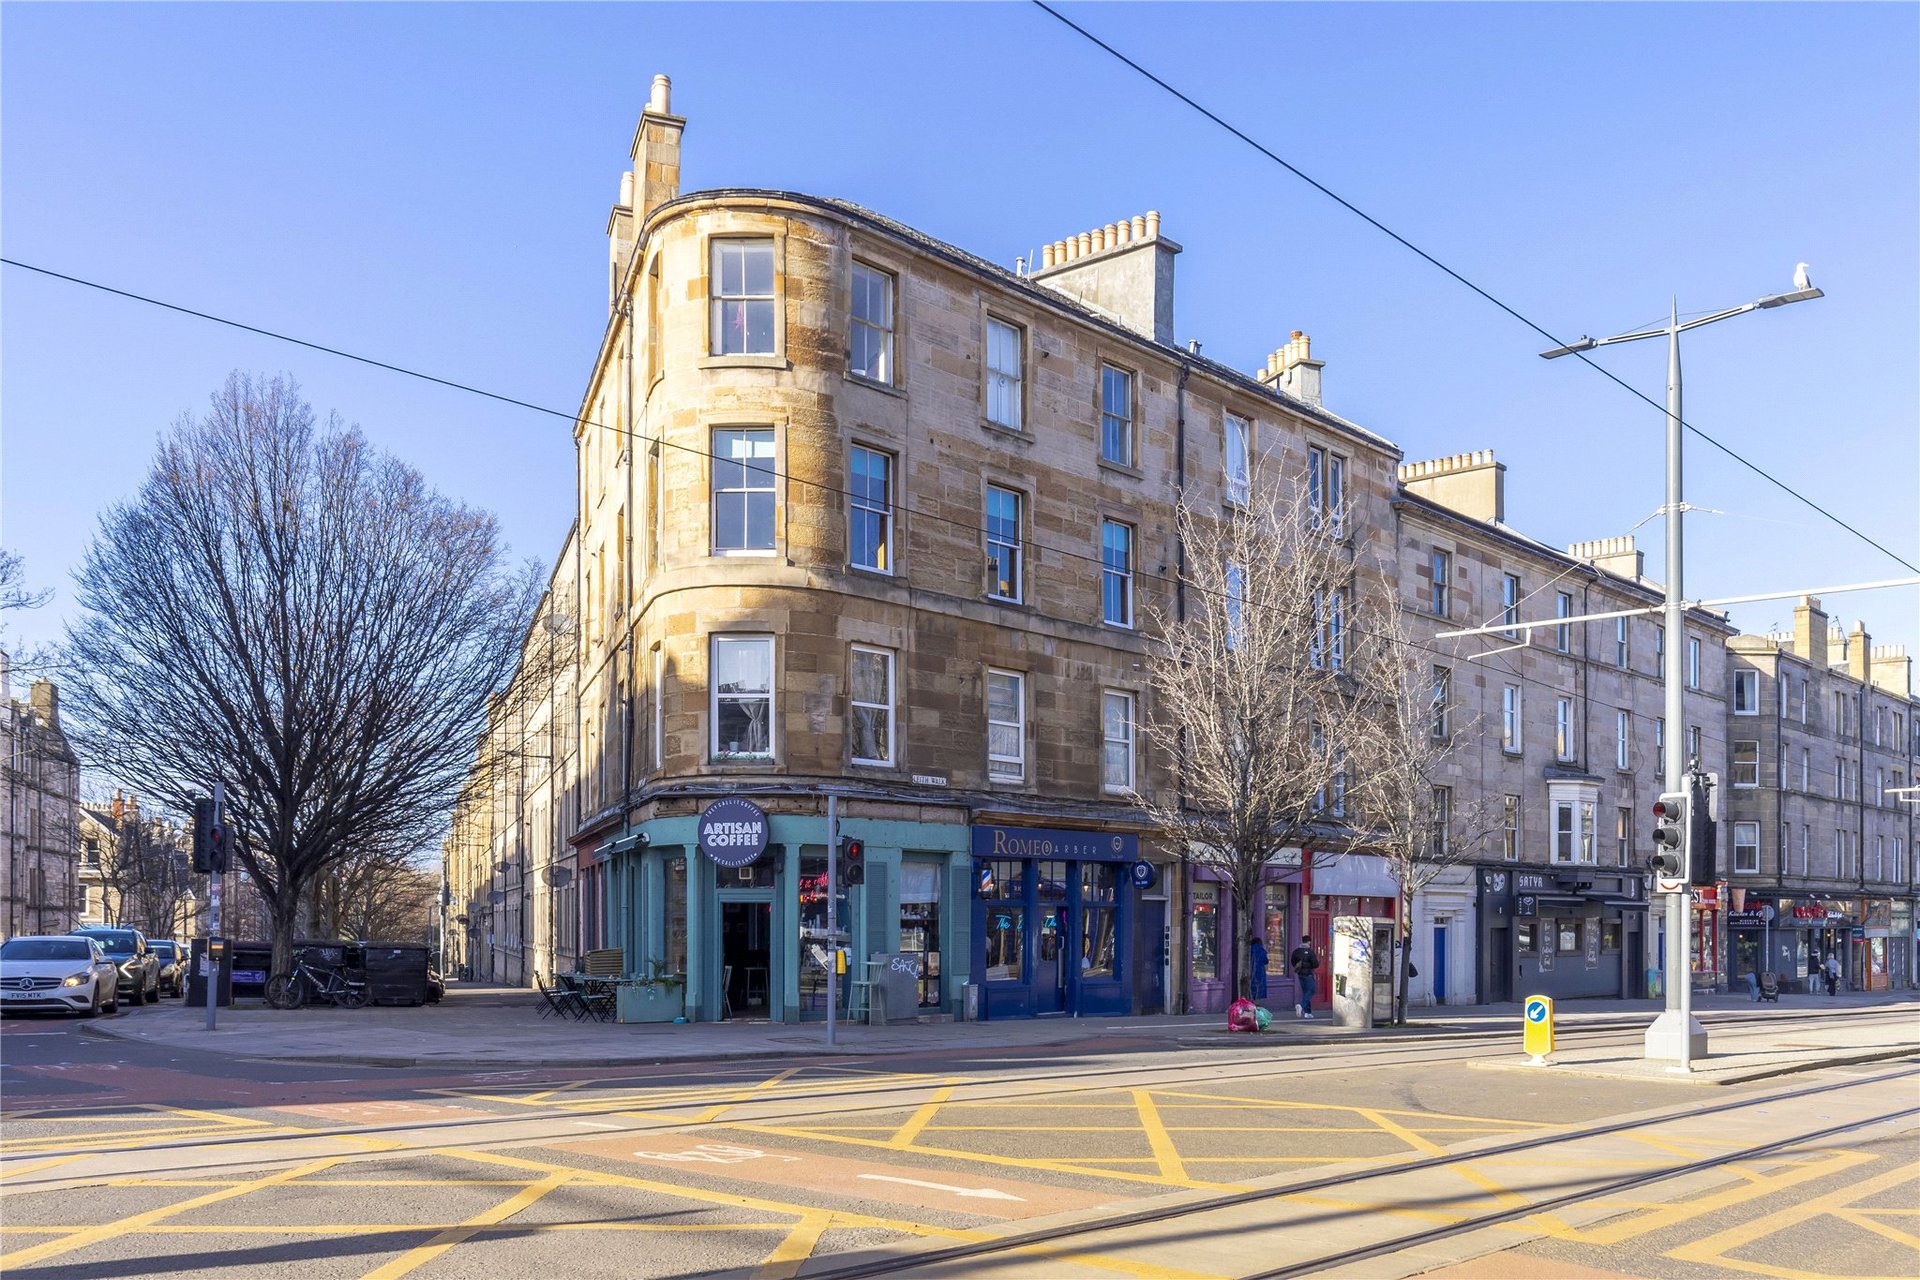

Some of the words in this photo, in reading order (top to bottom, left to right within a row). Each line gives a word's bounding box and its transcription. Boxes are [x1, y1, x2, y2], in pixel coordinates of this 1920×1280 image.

[718, 800, 733, 808] CALL
[740, 801, 760, 817] COFFEE
[703, 822, 762, 835] ARTISAN
[707, 834, 759, 847] COFFEE
[993, 830, 1052, 856] ROMEO
[1043, 842, 1097, 855] BARBER
[1519, 875, 1543, 888] SATYA
[1193, 892, 1213, 900] TAILOR
